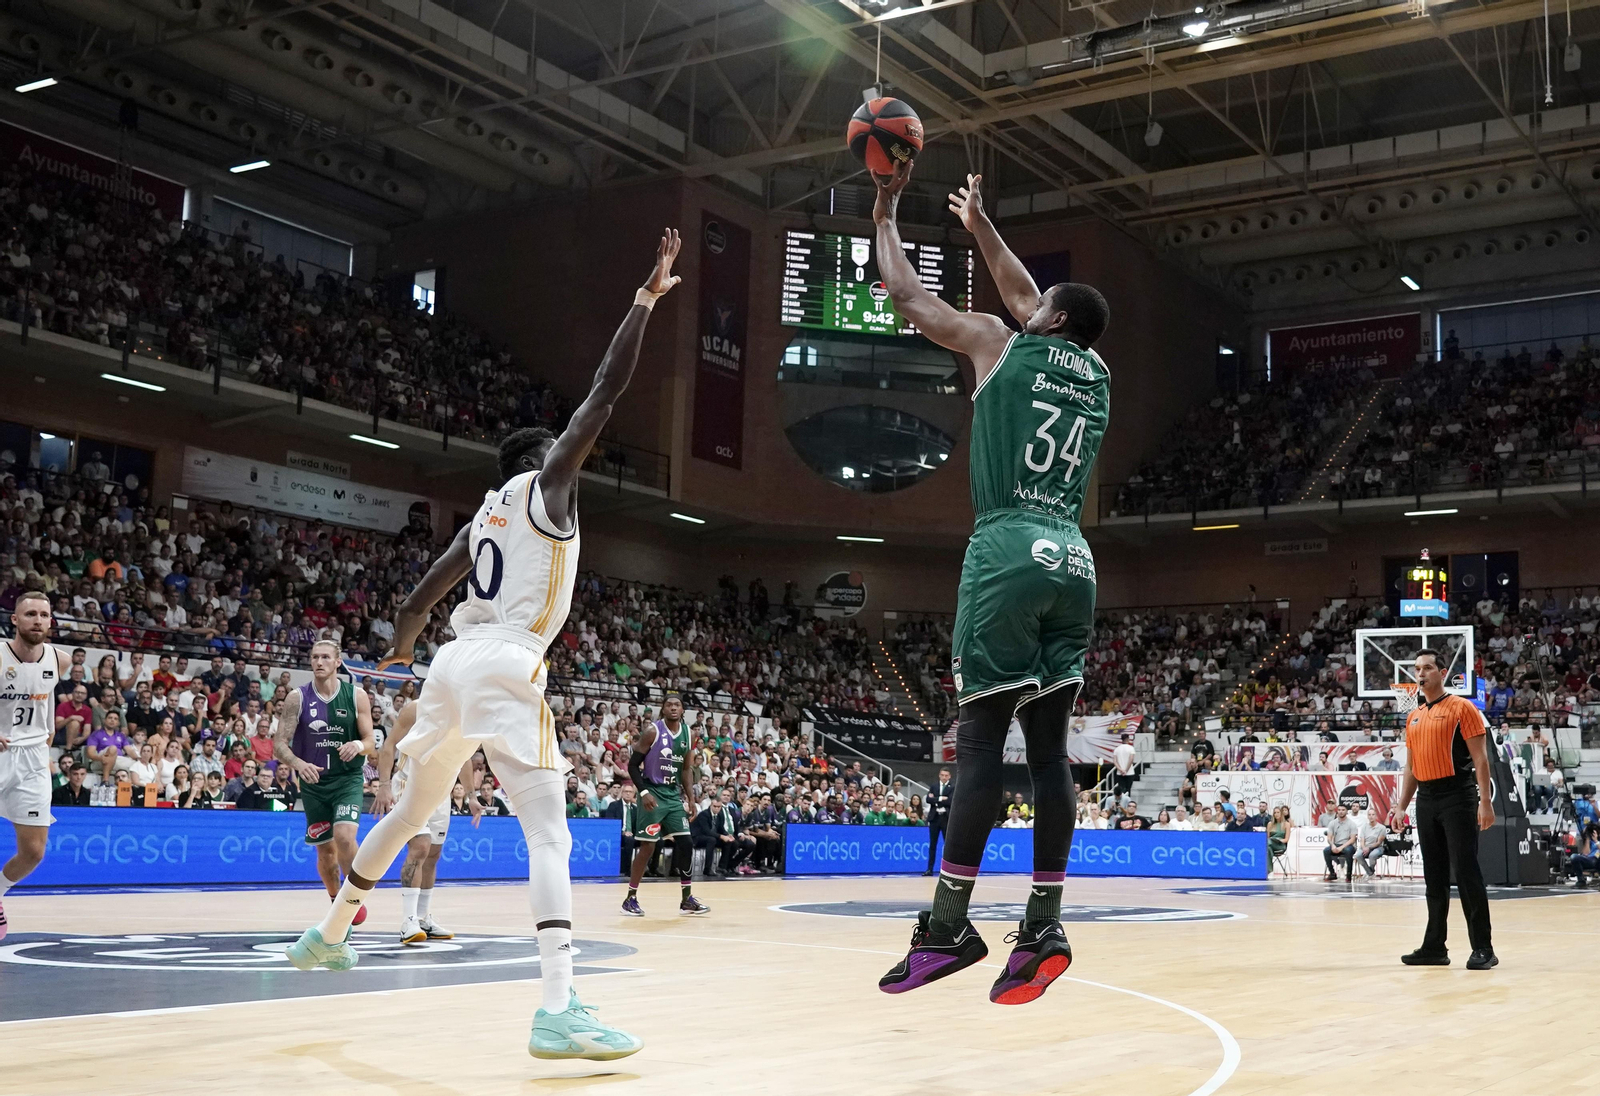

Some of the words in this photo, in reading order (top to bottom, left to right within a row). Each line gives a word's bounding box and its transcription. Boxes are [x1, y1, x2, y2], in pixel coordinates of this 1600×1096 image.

[18, 144, 156, 206] Ayuntaminto
[856, 267, 864, 281] 0
[847, 300, 853, 310] 0
[875, 302, 884, 311] 1T
[863, 311, 894, 324] 9:42
[702, 335, 740, 361] UCAM
[1288, 328, 1404, 353] Ayuntamiento
[702, 351, 740, 371] UNIVERSIDAD
[1048, 346, 1094, 380] THOMA
[1025, 400, 1086, 482] 34
[716, 444, 733, 459] acb
[323, 461, 348, 475] Norte
[291, 481, 326, 495] endesa
[490, 516, 508, 527] RO
[470, 538, 503, 600] 0
[1068, 555, 1087, 568] DEL
[1068, 566, 1096, 585] MÁLAG
[1422, 581, 1433, 600] 6
[13, 707, 34, 726] 31
[1006, 746, 1025, 754] #Supe
[327, 754, 330, 770] 1
[218, 827, 313, 863] ende
[1305, 835, 1325, 843] acb
[1519, 838, 1530, 854] acb
[442, 837, 493, 861] esa
[793, 835, 859, 861] endesa
[872, 836, 930, 861] endesa
[1069, 839, 1131, 864] desa
[1151, 841, 1255, 866] endesa
